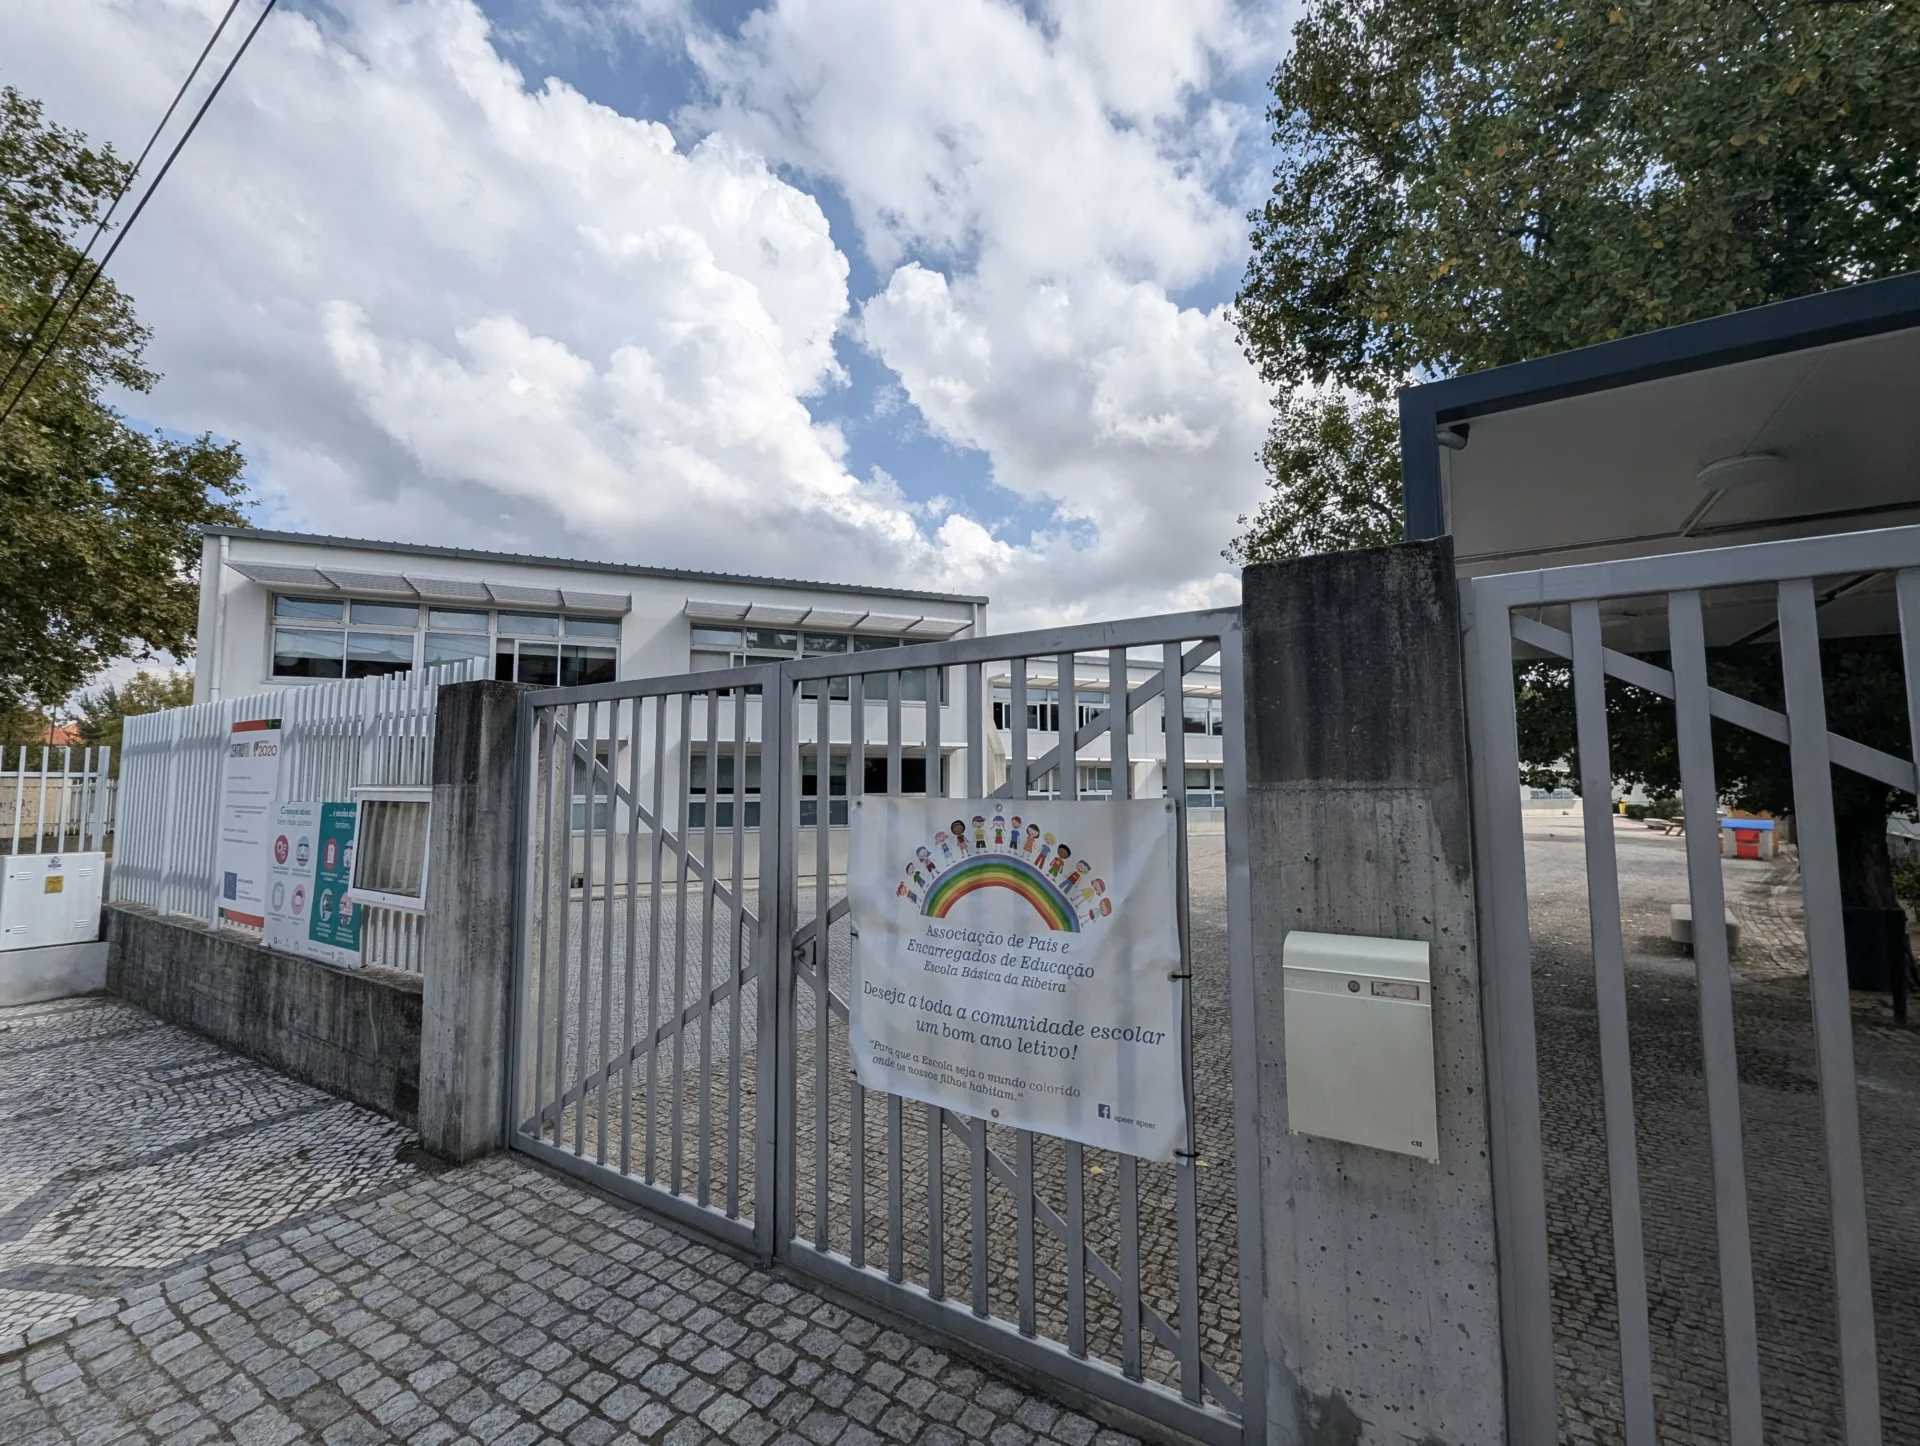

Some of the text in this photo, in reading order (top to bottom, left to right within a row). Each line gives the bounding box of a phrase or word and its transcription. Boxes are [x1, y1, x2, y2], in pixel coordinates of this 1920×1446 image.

[258, 744, 277, 756] 2020
[926, 924, 1070, 953] Associação de Pais e
[907, 938, 1095, 979] Encarregados de Educação
[923, 960, 1066, 993] Escola Básica da Ribeira
[863, 981, 1166, 1046] Deseja a toda a comunidade escolar
[916, 1019, 1078, 1060] um bom ano letivo!
[872, 1055, 895, 1068] onde
[897, 1062, 906, 1072] os
[908, 1065, 938, 1081] nossos
[939, 1073, 967, 1089] filhos
[895, 1048, 911, 1061] que
[913, 1054, 920, 1063] a
[921, 1055, 953, 1072] Escola
[955, 1065, 976, 1078] seja
[978, 1070, 985, 1080] o
[987, 1073, 1026, 1089] mundo
[1029, 1082, 1081, 1098] colorido
